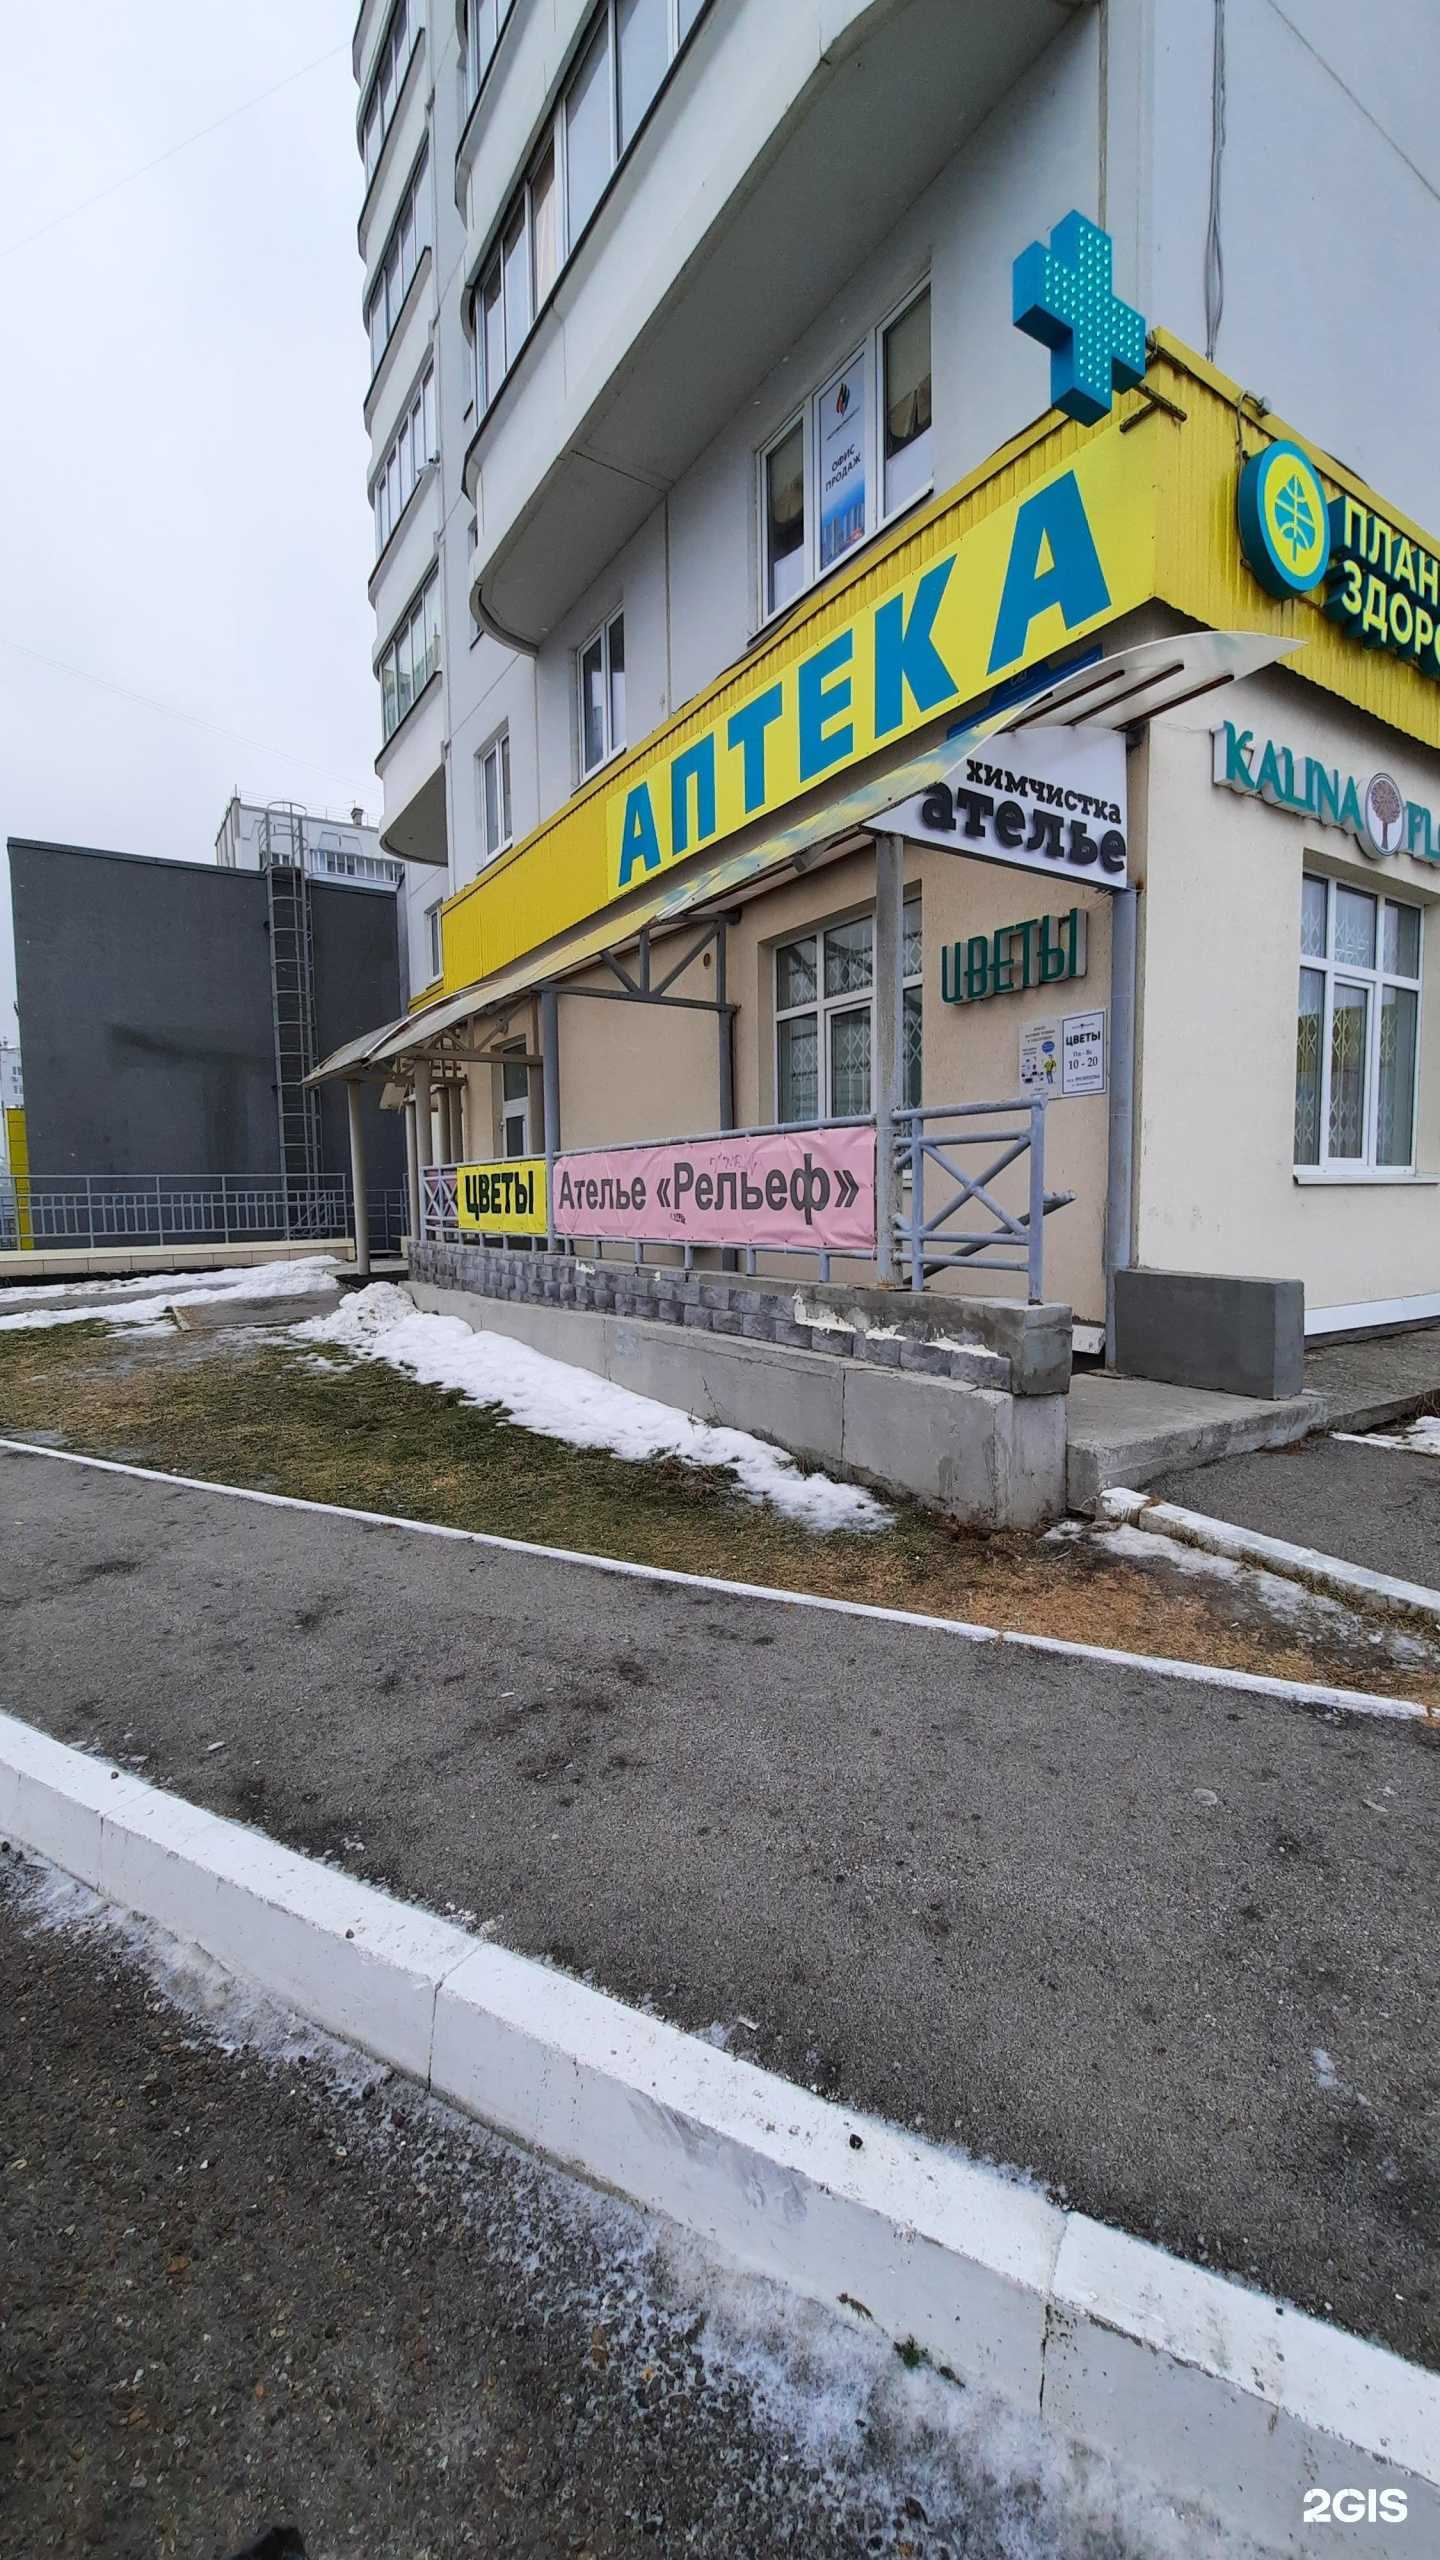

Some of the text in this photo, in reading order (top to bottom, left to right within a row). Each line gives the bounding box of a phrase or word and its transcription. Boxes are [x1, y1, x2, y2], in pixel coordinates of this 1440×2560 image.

[825, 452, 862, 493] ПРОДАЖ
[831, 443, 856, 472] ОФИС
[1341, 560, 1440, 666] ЗДОР
[618, 469, 1112, 888] АПТЕКА
[1223, 720, 1440, 861] KALINA PL
[921, 782, 1127, 873] ателье
[941, 907, 1087, 1004] ЦВЕТЫ
[1065, 1030, 1101, 1047] ЦВЕТЫ
[1069, 1059, 1079, 1070] 10
[1088, 1056, 1098, 1067] 20
[465, 1170, 534, 1221] ЦВЕТЫ
[558, 1153, 861, 1226] Ателье «Рельеф»
